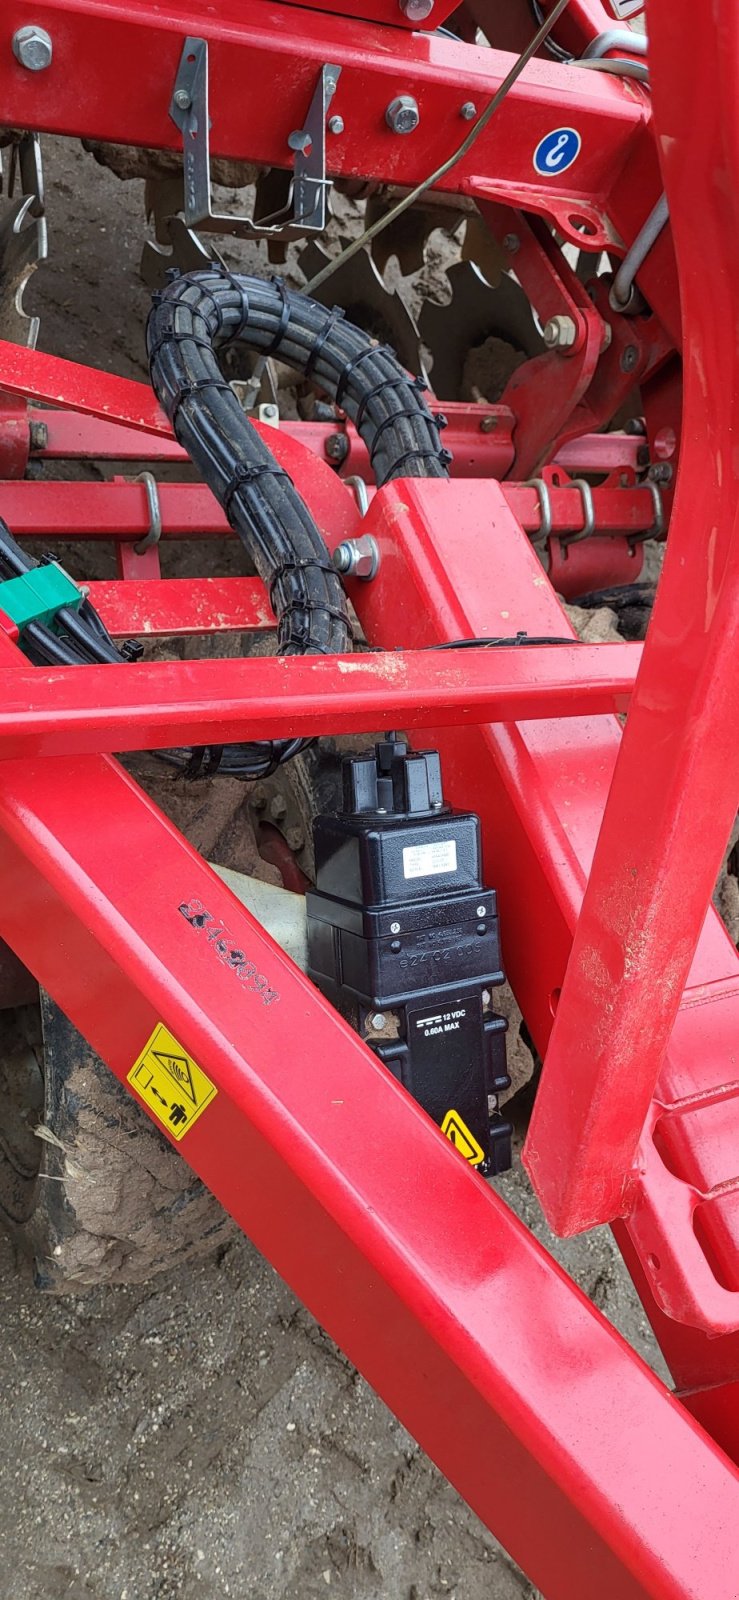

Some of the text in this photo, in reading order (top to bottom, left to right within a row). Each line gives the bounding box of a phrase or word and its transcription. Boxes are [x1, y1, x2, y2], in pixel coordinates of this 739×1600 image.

[443, 1009, 466, 1021] 12 VDC
[424, 1021, 460, 1037] 0.60A MAX
